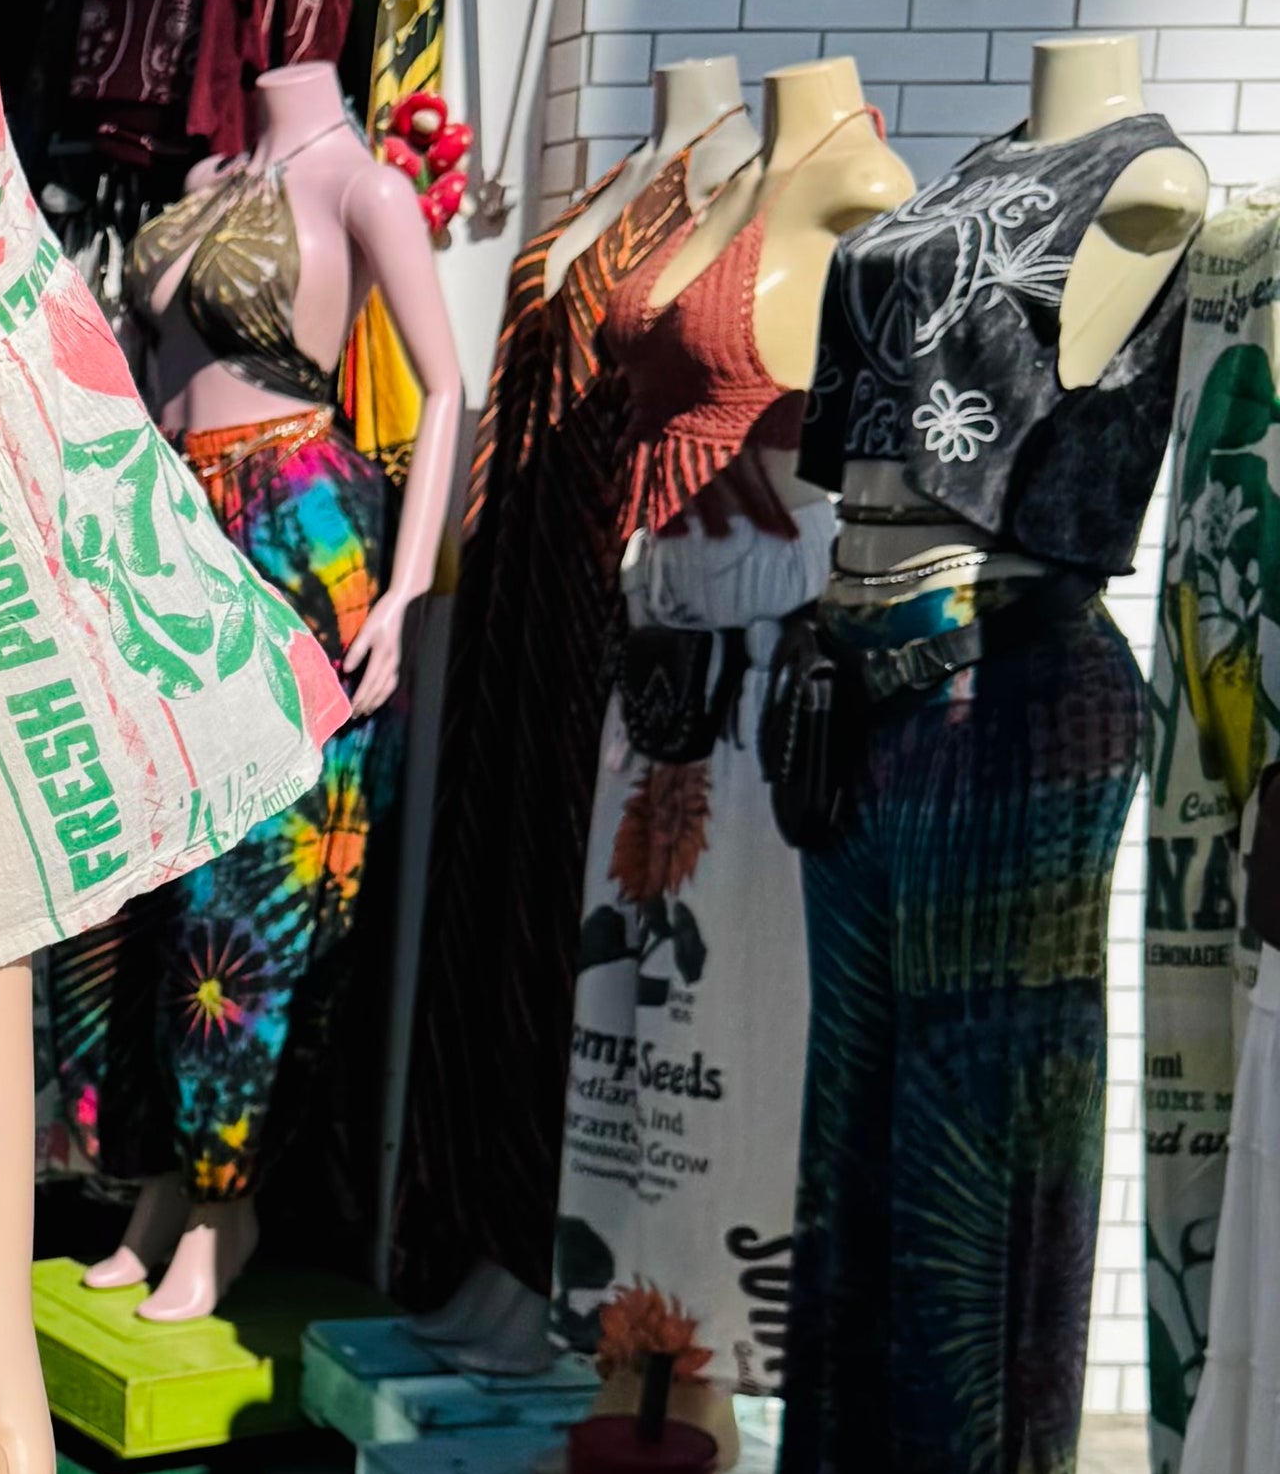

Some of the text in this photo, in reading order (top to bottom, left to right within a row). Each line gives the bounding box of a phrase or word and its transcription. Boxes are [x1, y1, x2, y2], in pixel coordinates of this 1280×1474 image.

[7, 677, 131, 894] FRESH
[638, 1041, 723, 1102] Seeds
[646, 1140, 709, 1174] Grow
